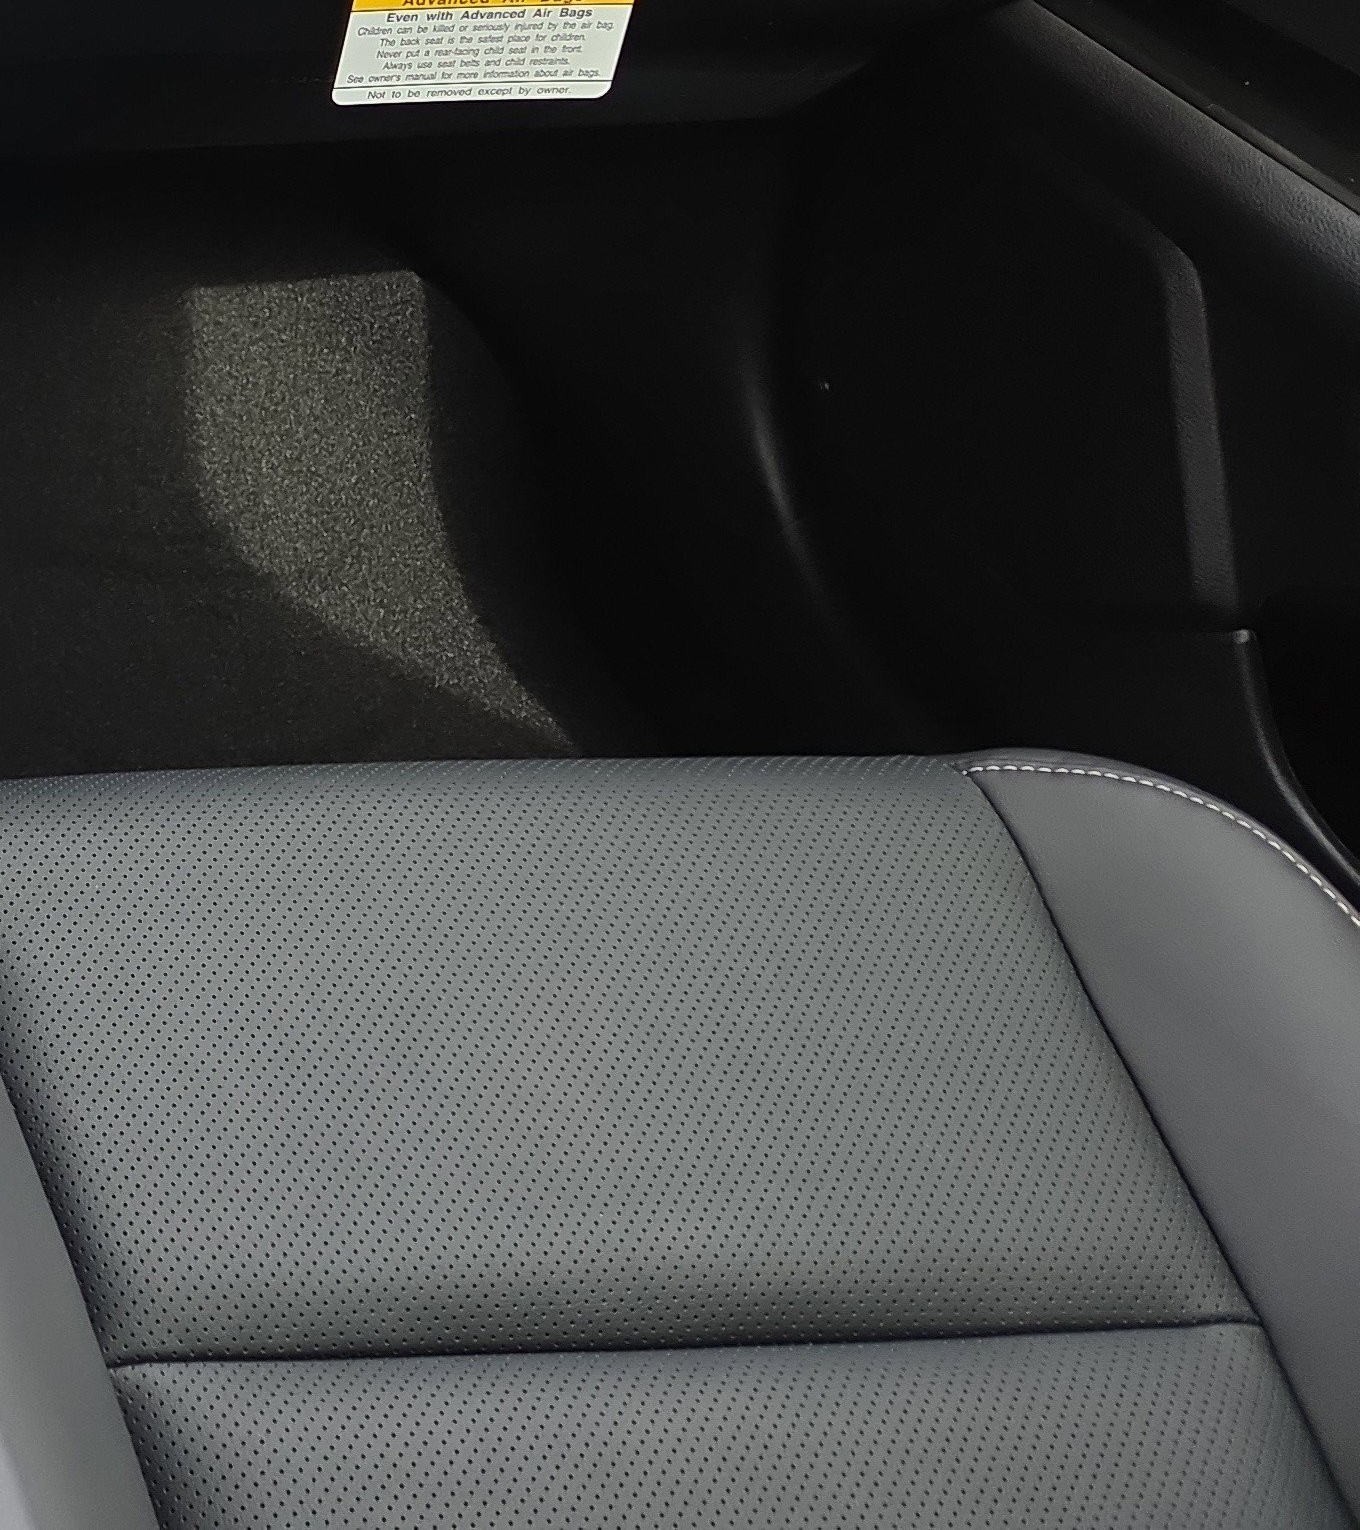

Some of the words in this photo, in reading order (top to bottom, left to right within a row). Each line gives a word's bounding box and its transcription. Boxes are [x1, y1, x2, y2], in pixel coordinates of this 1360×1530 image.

[386, 12, 418, 23] Even
[426, 10, 453, 22] with
[460, 9, 526, 21] Advanced
[532, 8, 553, 19] Air
[559, 7, 593, 20] Bags
[357, 26, 393, 37] Children
[417, 25, 429, 35] be
[547, 21, 559, 31] by
[562, 20, 576, 30] the
[580, 21, 592, 30] air
[380, 38, 396, 47] The
[400, 37, 420, 46] back
[424, 37, 444, 45] seat
[447, 36, 456, 44] is
[459, 35, 473, 44] the
[535, 33, 547, 43] for
[376, 50, 402, 59] Never
[405, 50, 420, 59] put
[483, 46, 505, 55] child
[508, 46, 527, 55] seat
[531, 45, 540, 54] in
[543, 45, 558, 54] the
[382, 61, 413, 71] Always
[437, 59, 456, 68] seat
[483, 58, 501, 67] and
[504, 57, 526, 67] child
[405, 71, 438, 82] manual
[440, 71, 453, 80] for
[456, 71, 479, 79] more
[533, 68, 559, 78] about
[367, 89, 387, 100] Not
[391, 90, 402, 99] to
[407, 88, 421, 98] be
[426, 87, 473, 98] removed
[477, 86, 513, 97] except
[518, 85, 531, 97] by
